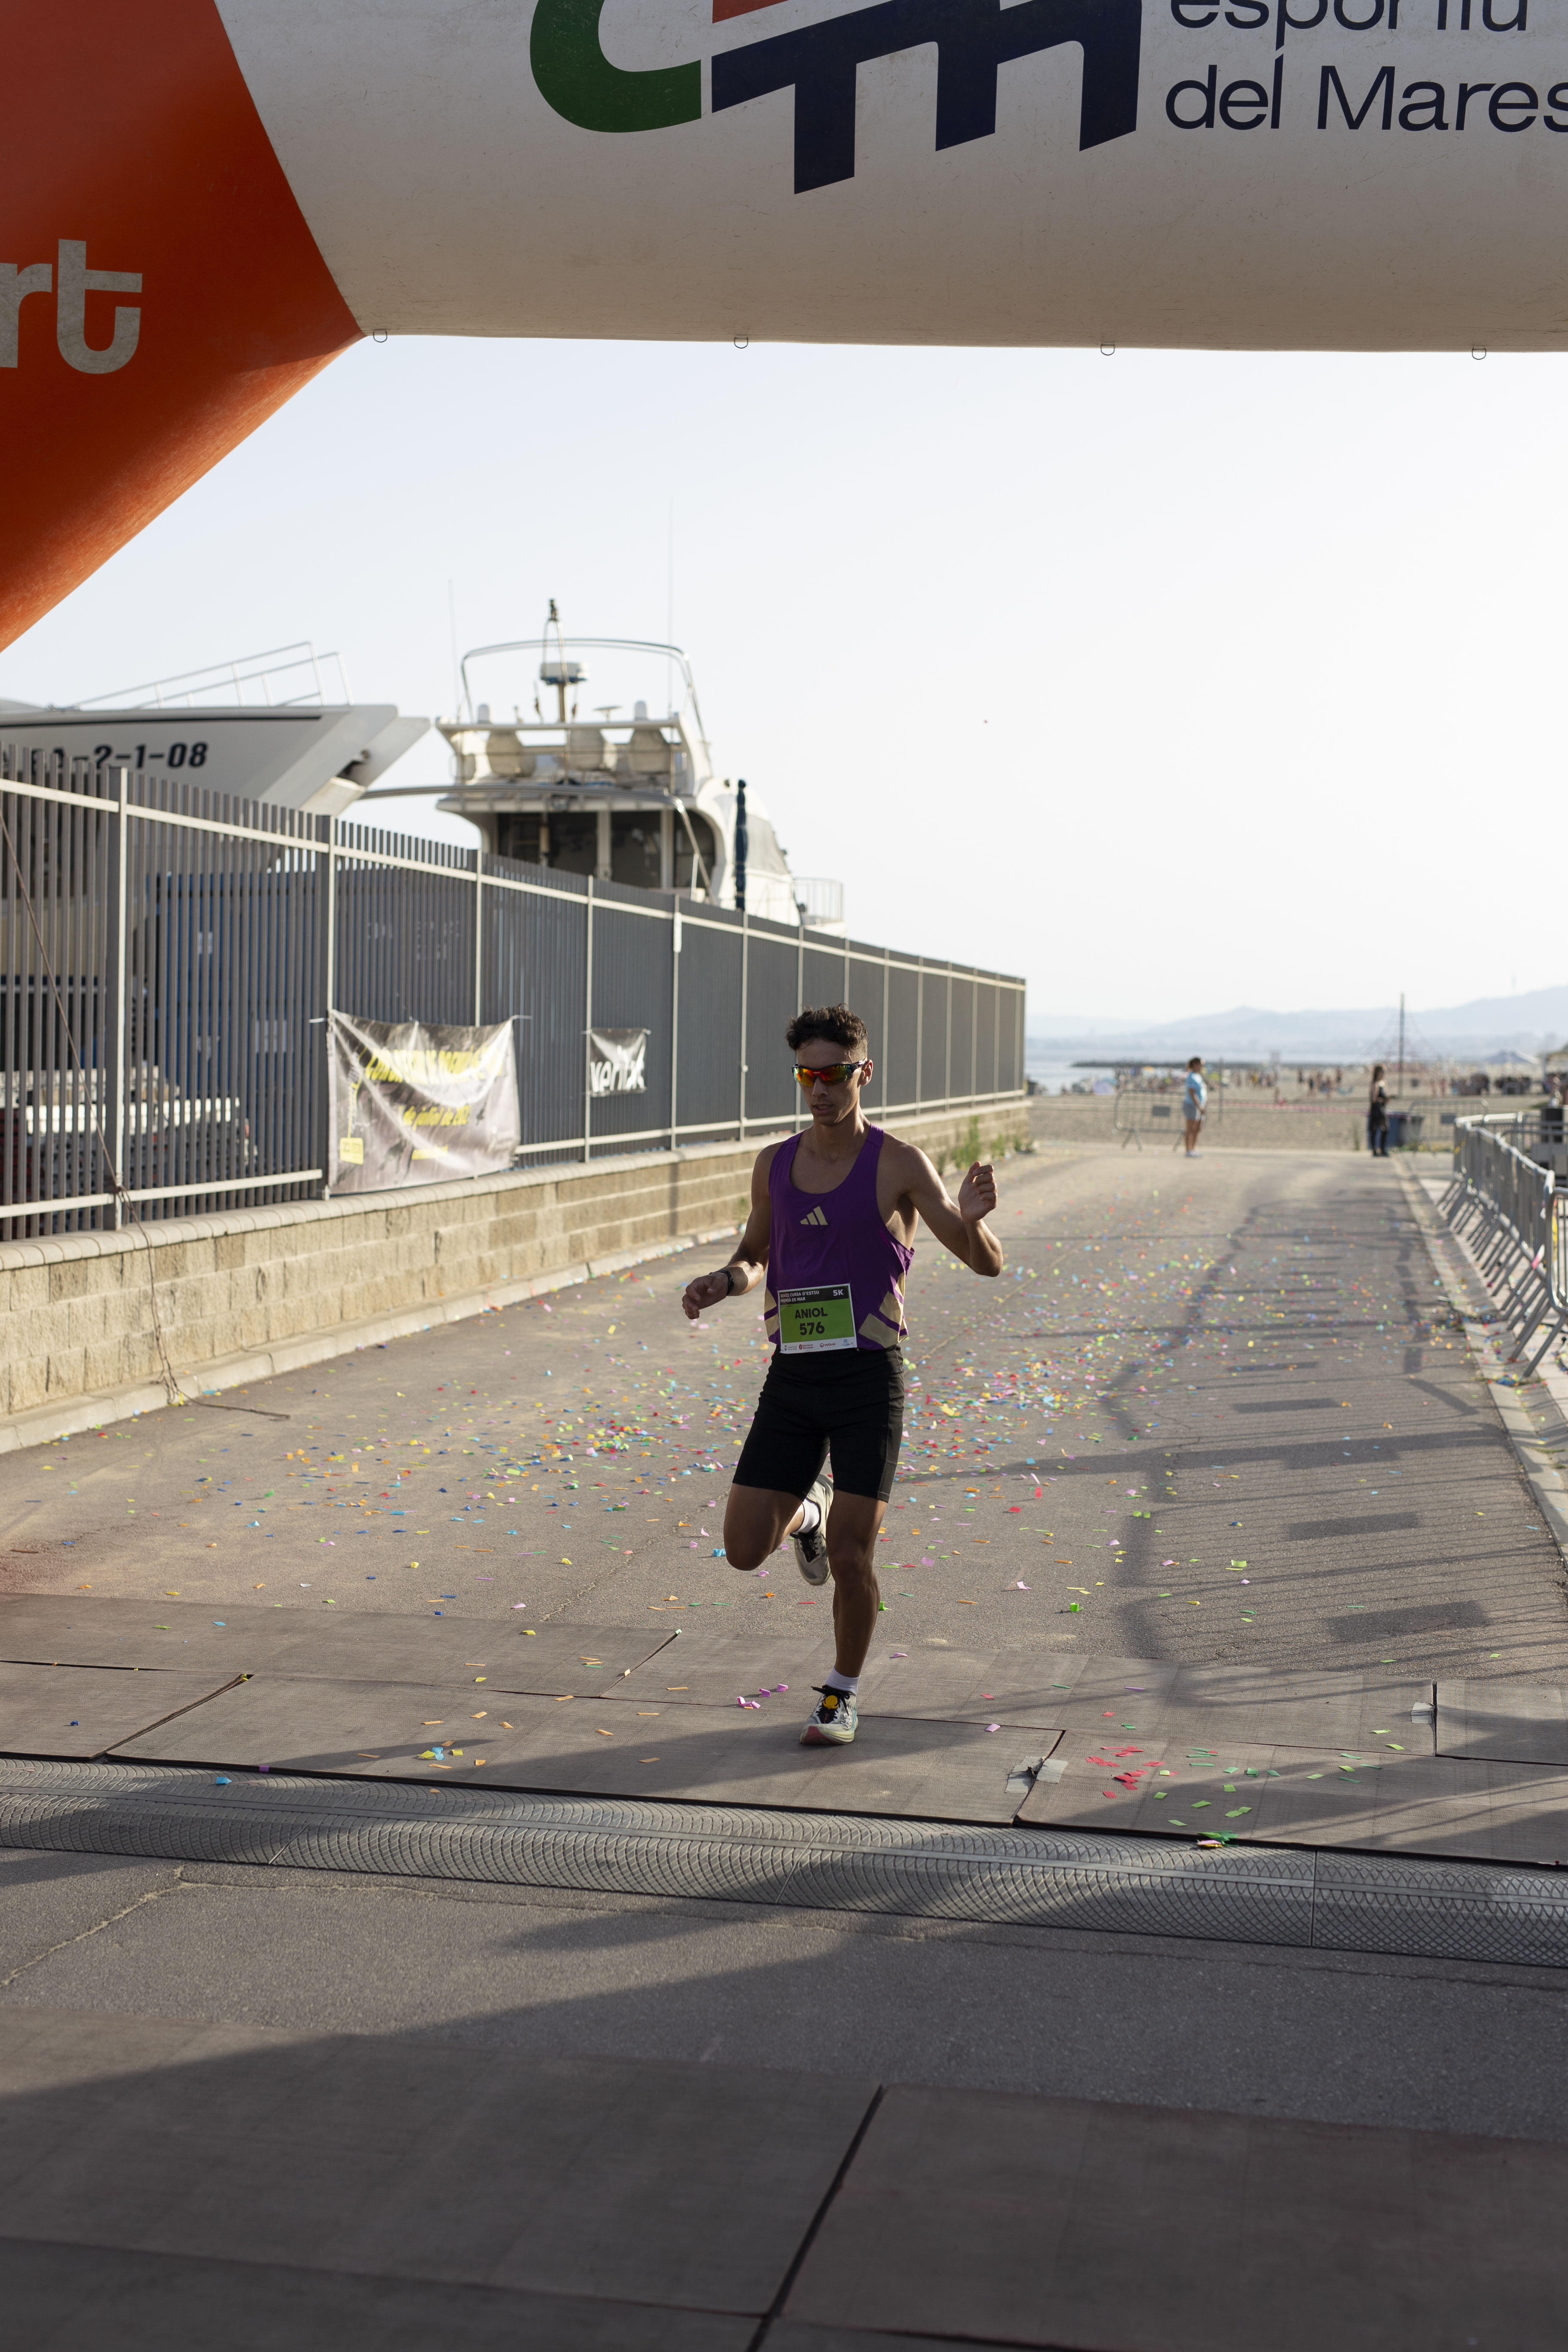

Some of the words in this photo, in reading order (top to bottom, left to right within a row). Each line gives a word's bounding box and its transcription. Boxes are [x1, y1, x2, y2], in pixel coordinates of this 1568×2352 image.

[1165, 53, 1284, 131] del
[795, 1307, 828, 1319] ANIOL
[800, 1321, 825, 1335] 576
